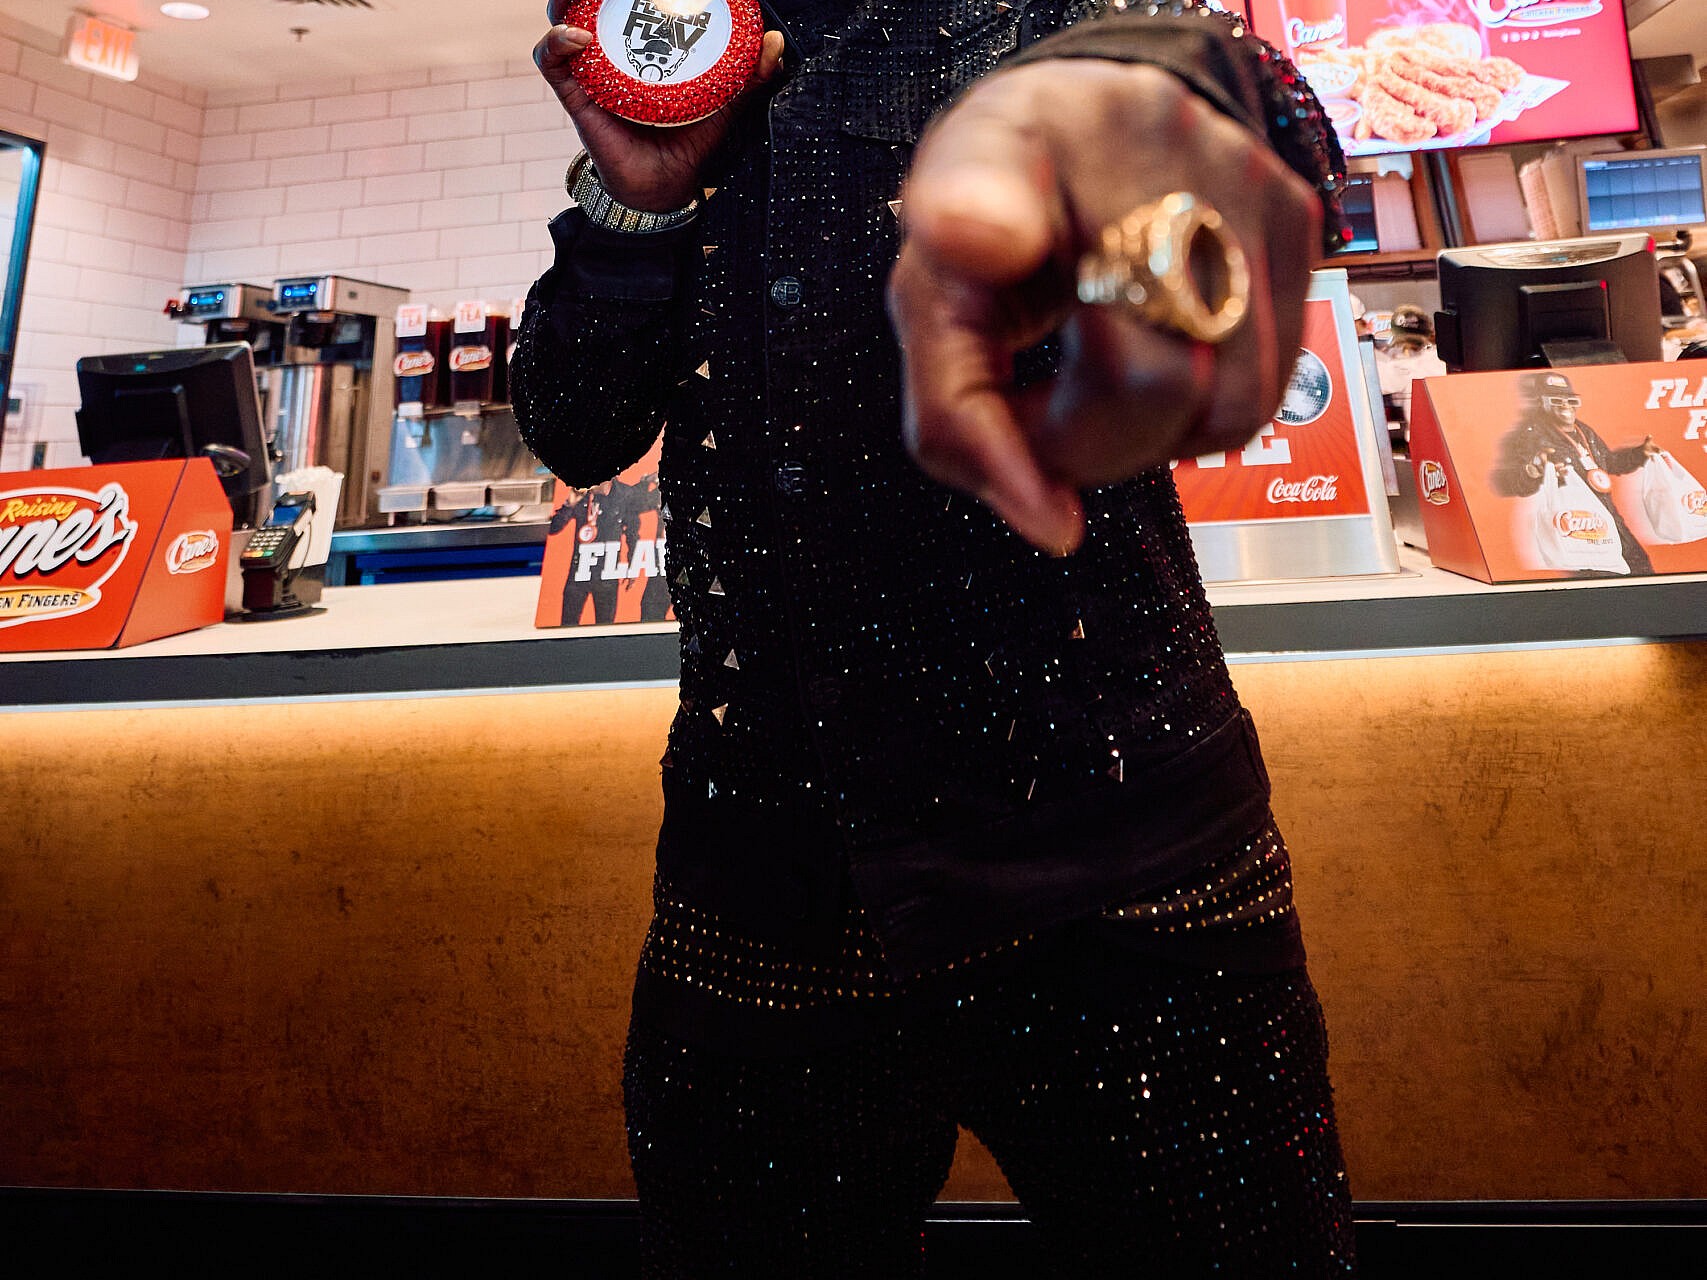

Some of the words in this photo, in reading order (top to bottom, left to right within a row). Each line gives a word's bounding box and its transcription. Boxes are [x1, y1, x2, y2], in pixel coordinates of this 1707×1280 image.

[623, 11, 707, 51] FLAV
[1267, 475, 1338, 503] Coca-Cola
[1, 496, 78, 523] Raising
[18, 592, 80, 609] FINGERS
